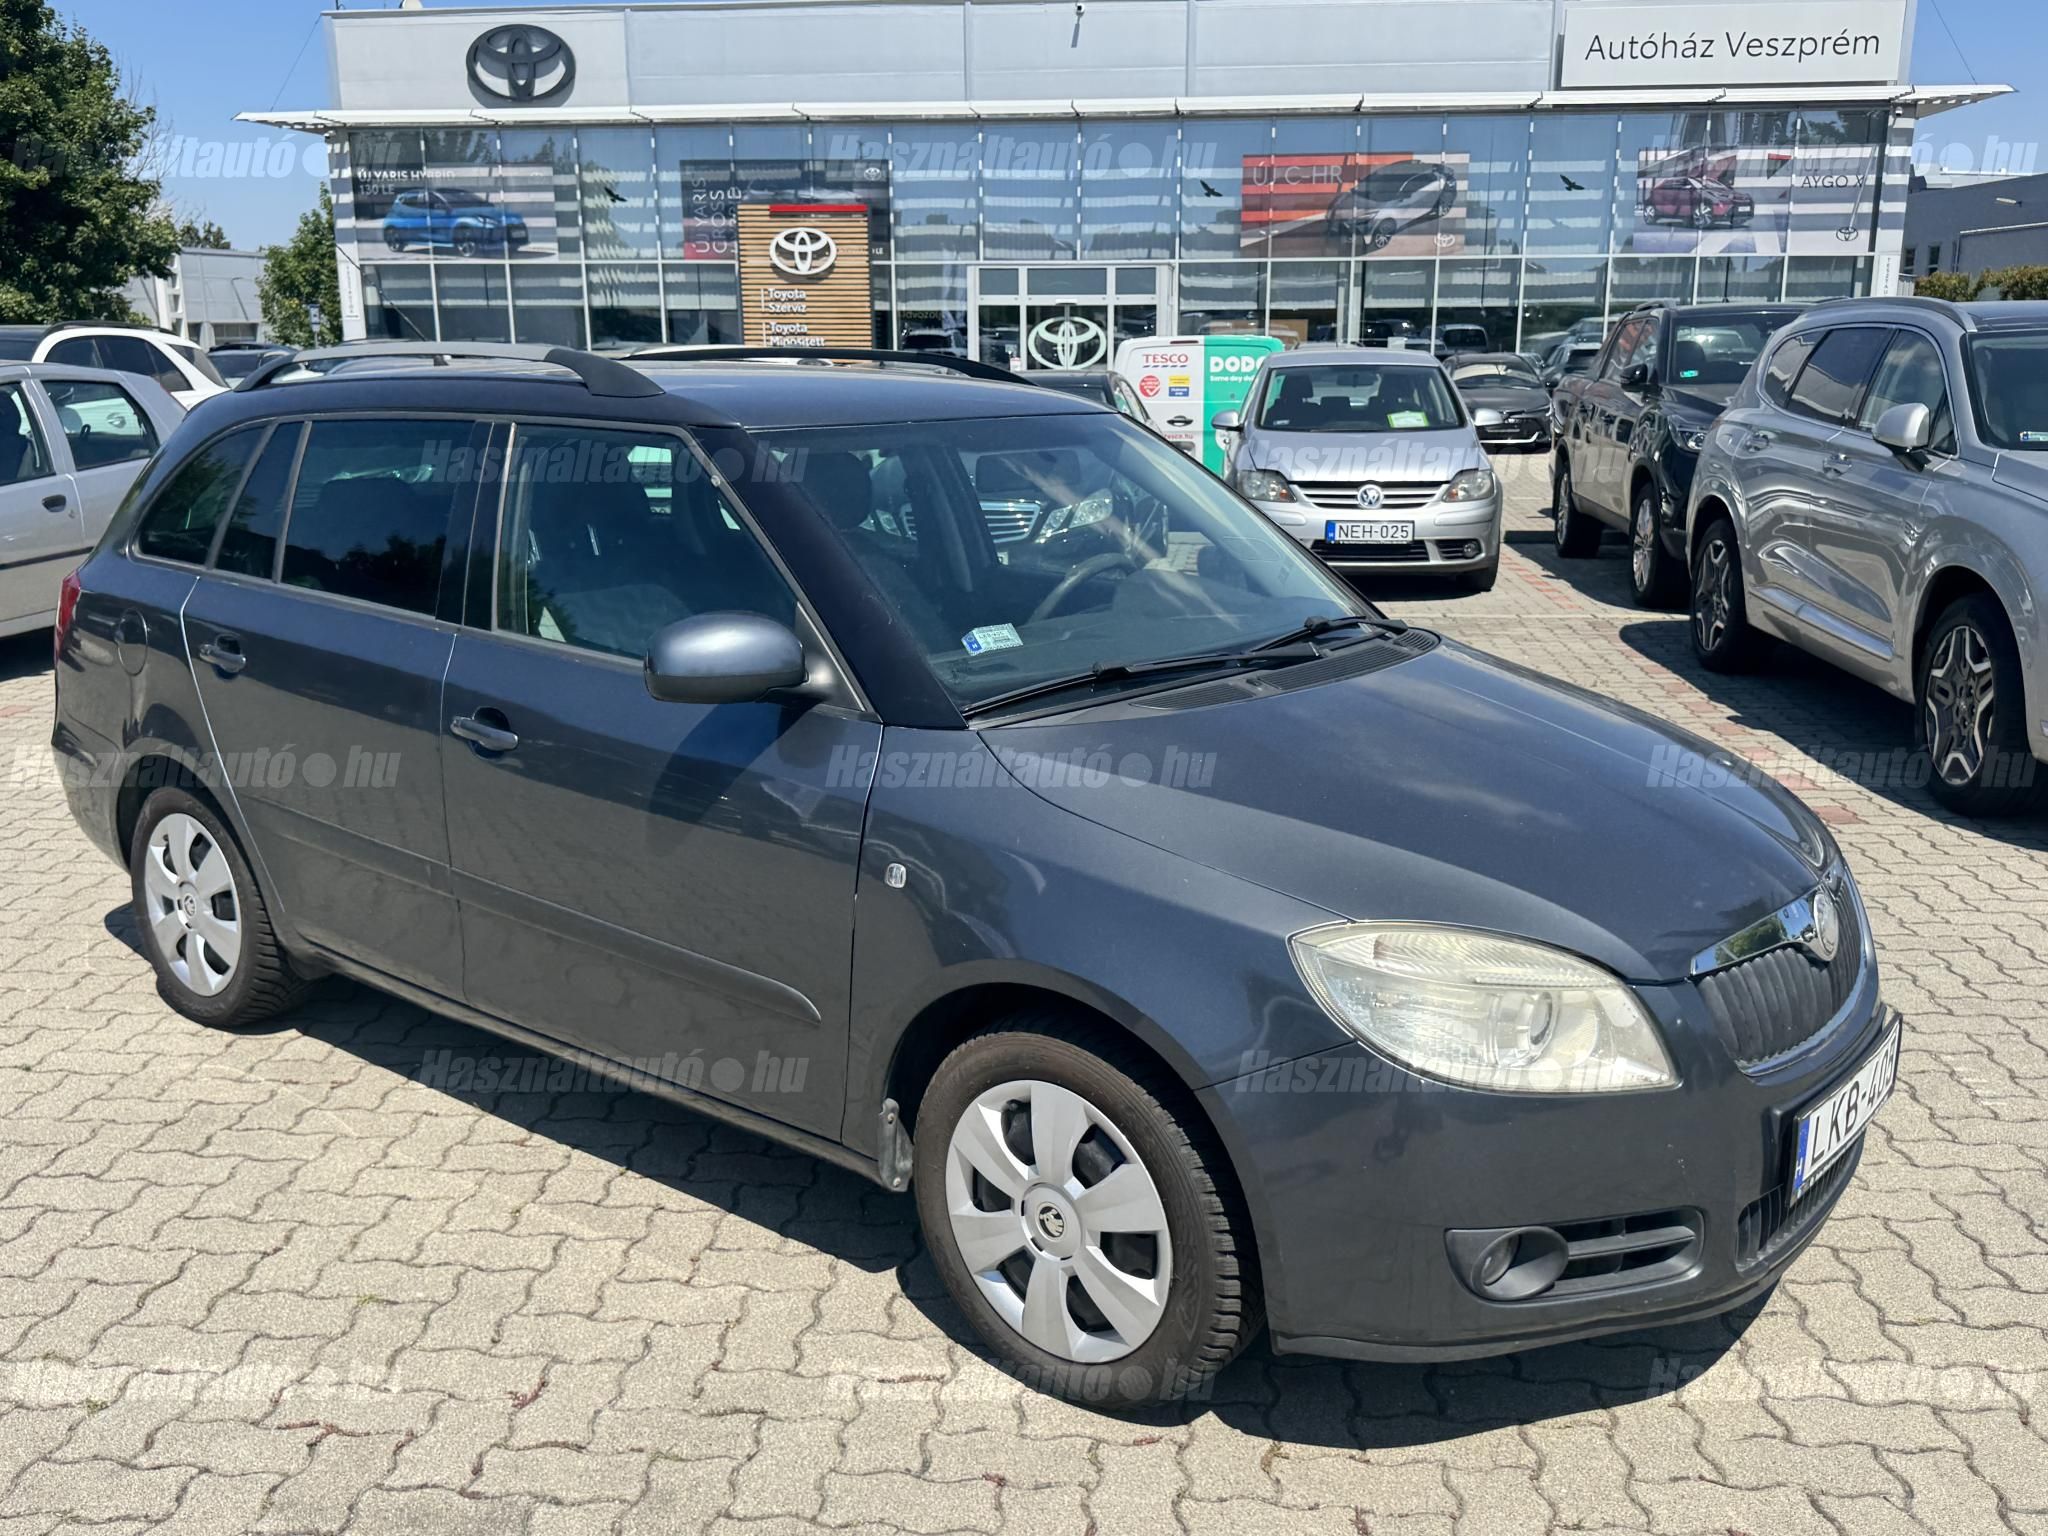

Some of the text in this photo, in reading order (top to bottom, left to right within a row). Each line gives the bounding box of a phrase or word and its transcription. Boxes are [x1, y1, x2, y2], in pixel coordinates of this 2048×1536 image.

[1585, 28, 1880, 63] Autóház Veszprém
[373, 170, 410, 181] YARIS
[1253, 160, 1343, 187] ÚJ C-HR
[1801, 174, 1849, 189] AYGO
[360, 183, 395, 195] 130 LE
[692, 176, 708, 228] YARIS
[709, 190, 727, 254] CROSS
[767, 288, 807, 302] Toyota
[767, 302, 807, 313] Szerviz
[769, 322, 808, 335] Toyota
[1142, 353, 1189, 364] TESCO
[1338, 524, 1410, 540] NEH-025
